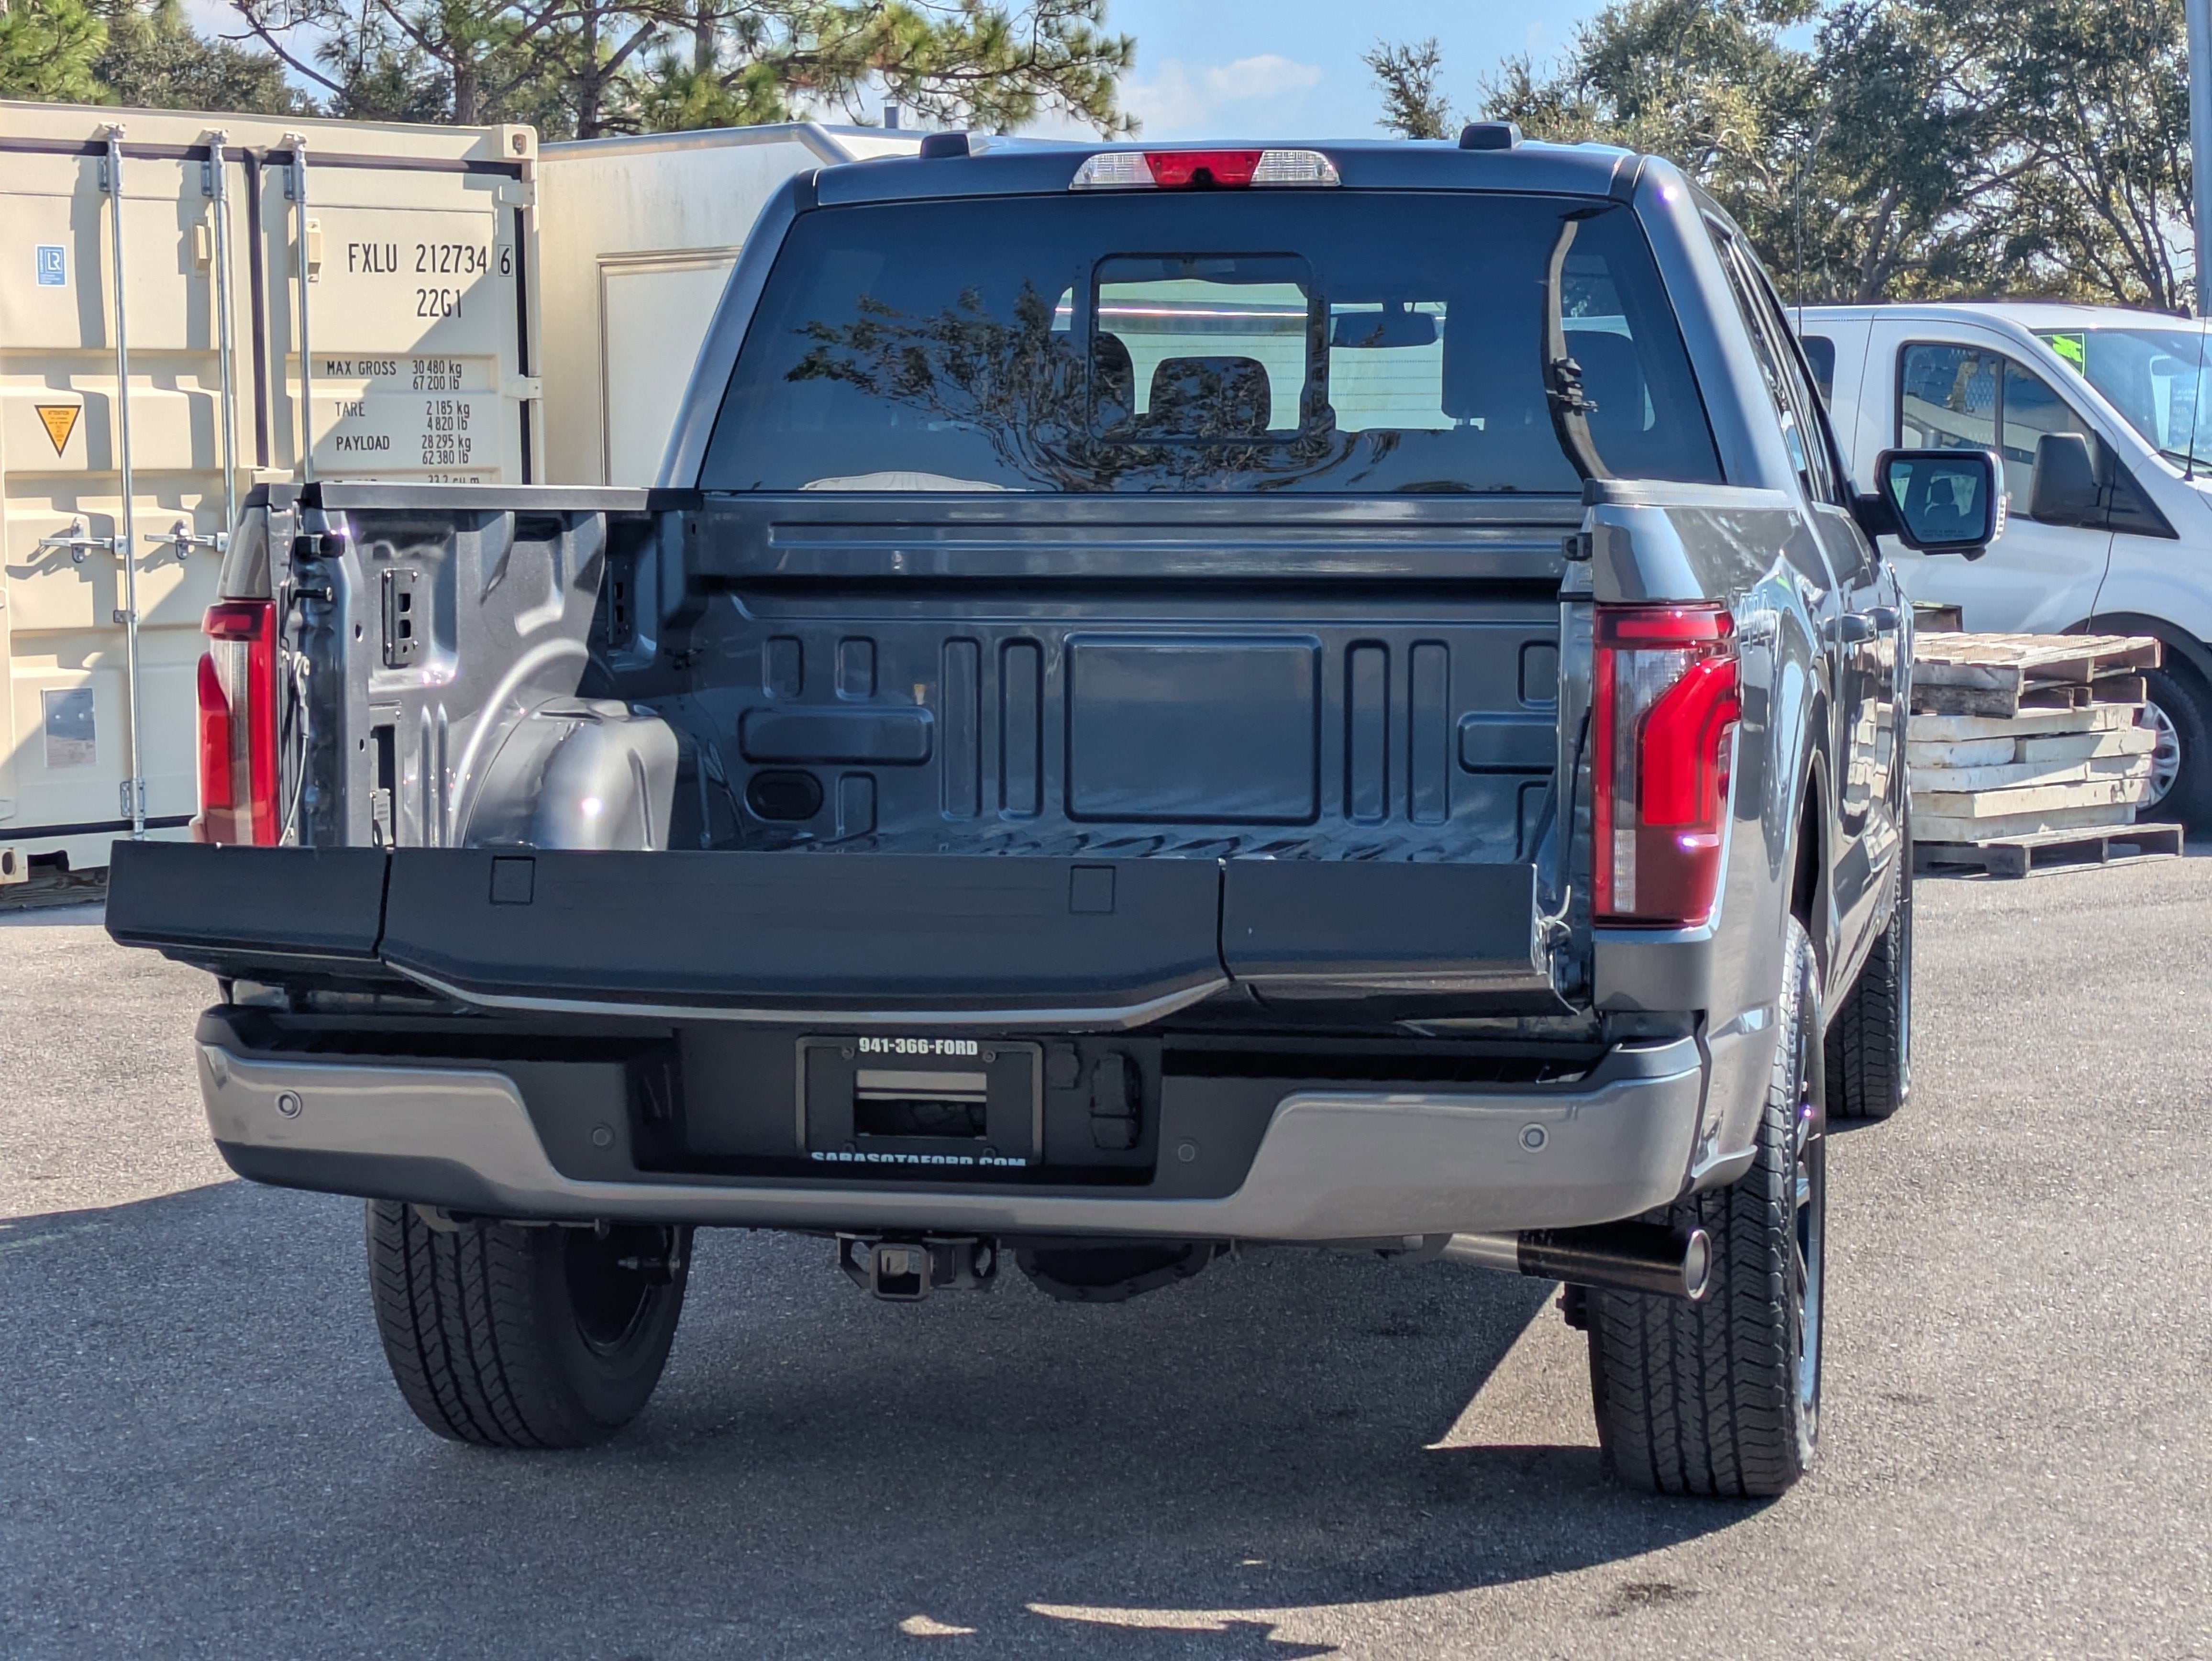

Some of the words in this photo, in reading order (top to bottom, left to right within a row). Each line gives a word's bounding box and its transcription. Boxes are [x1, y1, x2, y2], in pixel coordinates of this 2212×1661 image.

[348, 243, 397, 272] FXLU
[415, 244, 487, 274] 212734
[500, 247, 510, 275] 6
[416, 288, 461, 318] 22G1
[327, 361, 352, 376] MAX
[358, 360, 397, 376] GROSS
[449, 360, 462, 378] kg
[449, 376, 460, 390] lb
[335, 401, 365, 417] TARE
[456, 400, 470, 418] kg
[457, 416, 468, 431] lb
[336, 435, 390, 451] PAYLOAD
[458, 434, 471, 452] kg
[458, 451, 469, 464] lb
[859, 1037, 978, 1055] 941-366-FORD
[811, 1152, 1026, 1166] SARASOTAFORDCOM
